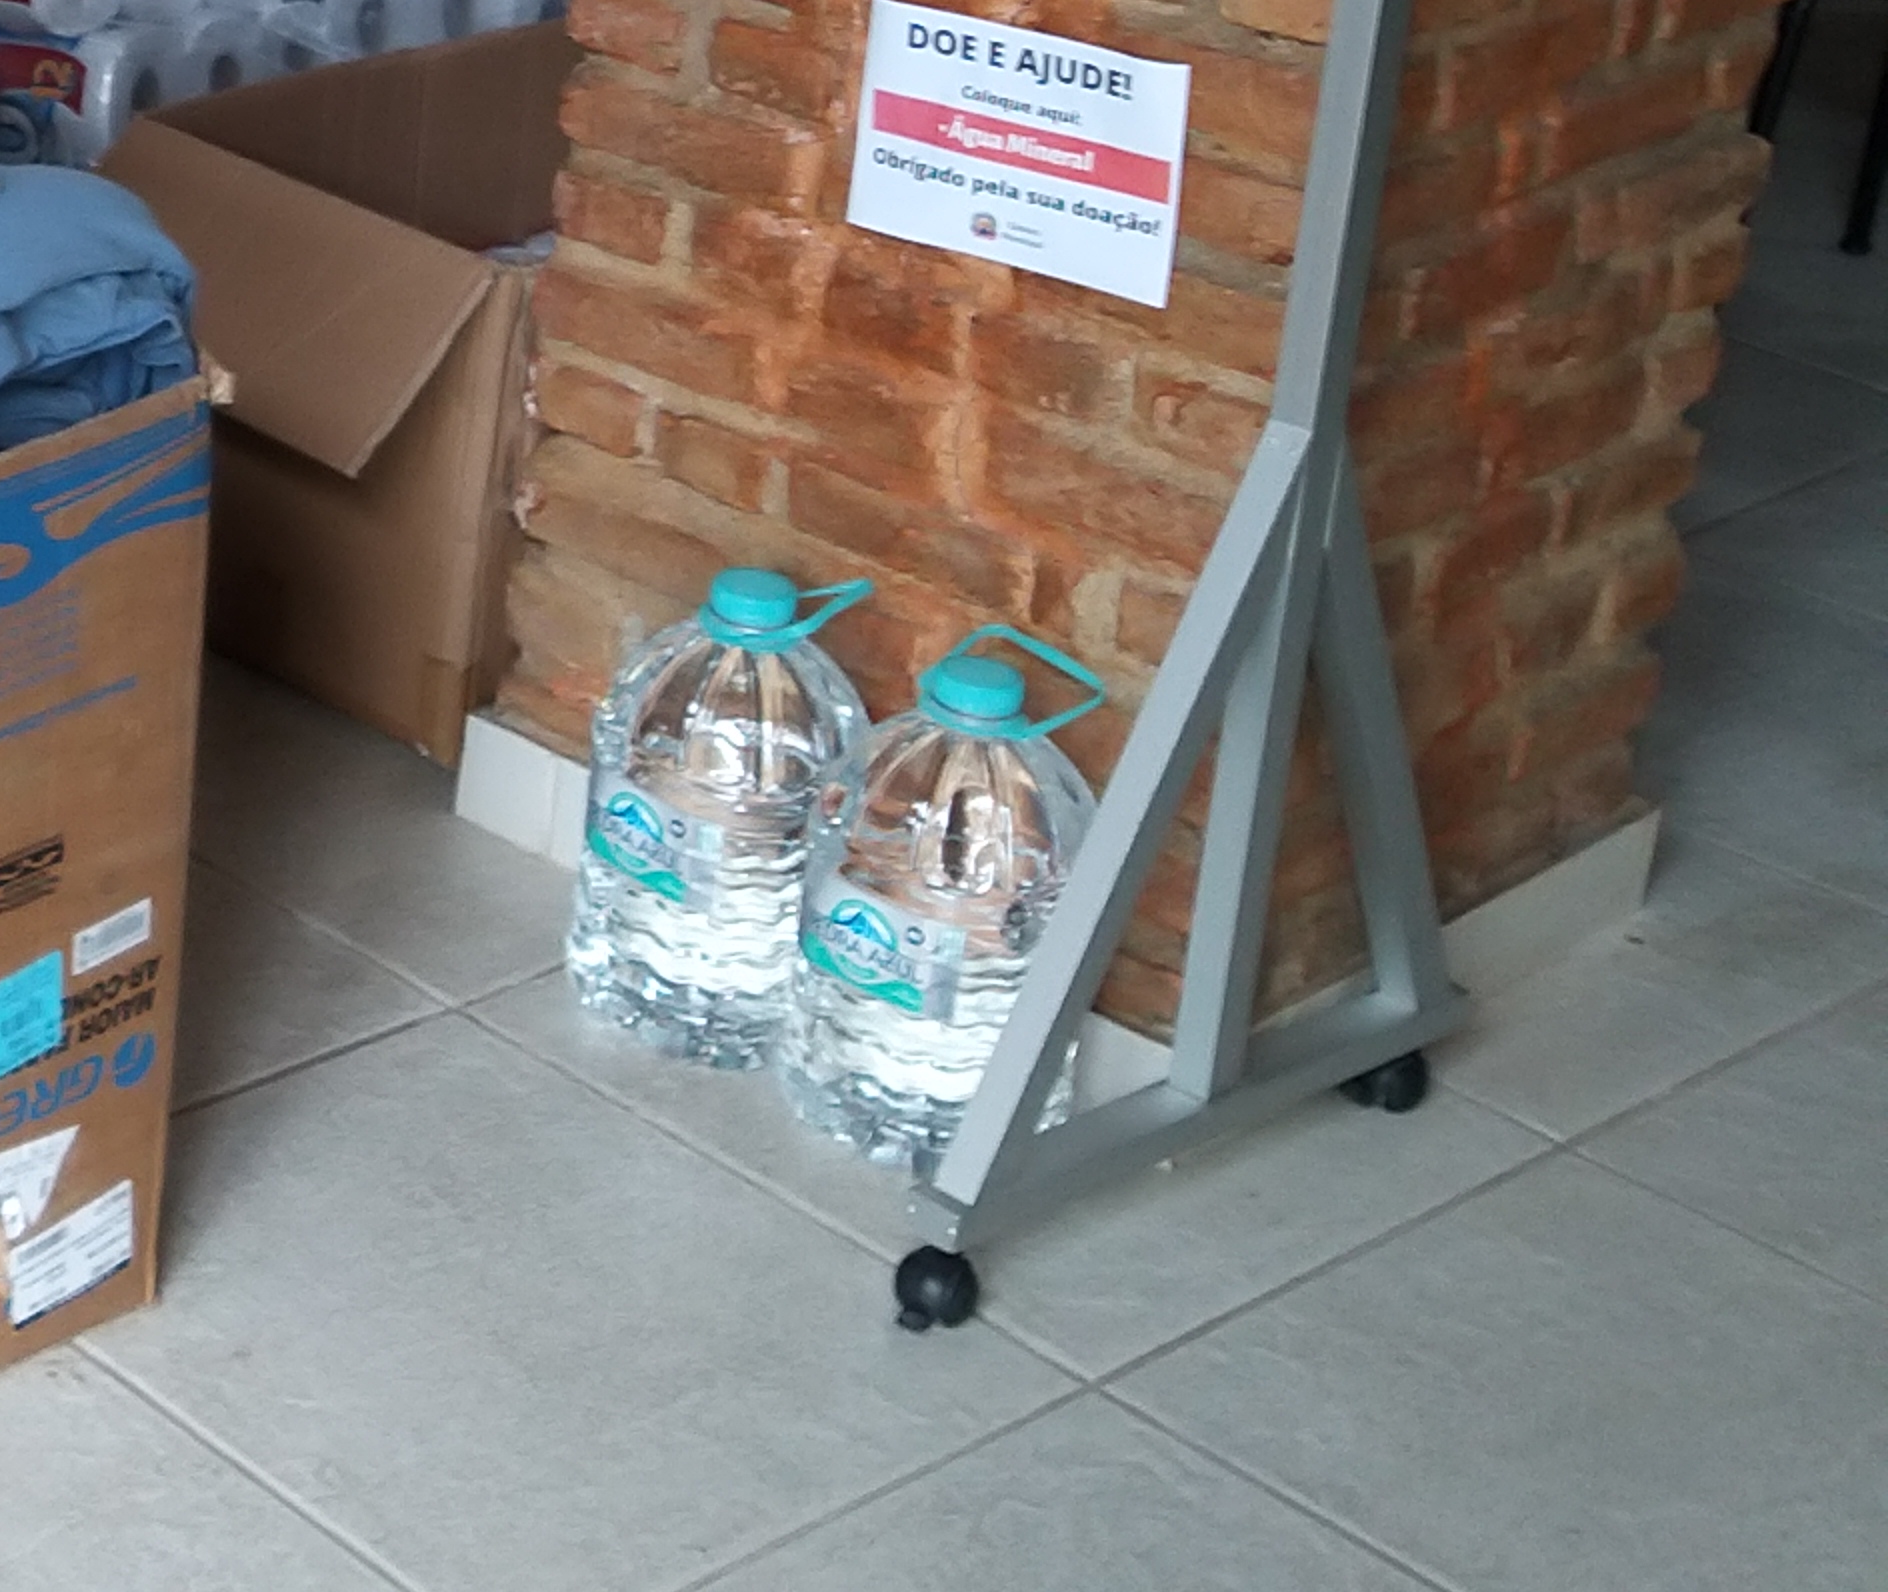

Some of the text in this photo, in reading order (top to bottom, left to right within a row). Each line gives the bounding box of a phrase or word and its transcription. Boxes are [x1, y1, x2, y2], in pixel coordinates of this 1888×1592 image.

[907, 21, 1134, 100] DOE E AJUDE!
[961, 84, 1083, 127] Coloque aqui:
[1005, 131, 1096, 174] Mineral
[871, 146, 1162, 238] Obrigado pela sua doação!
[79, 986, 158, 1043] MAIOR
